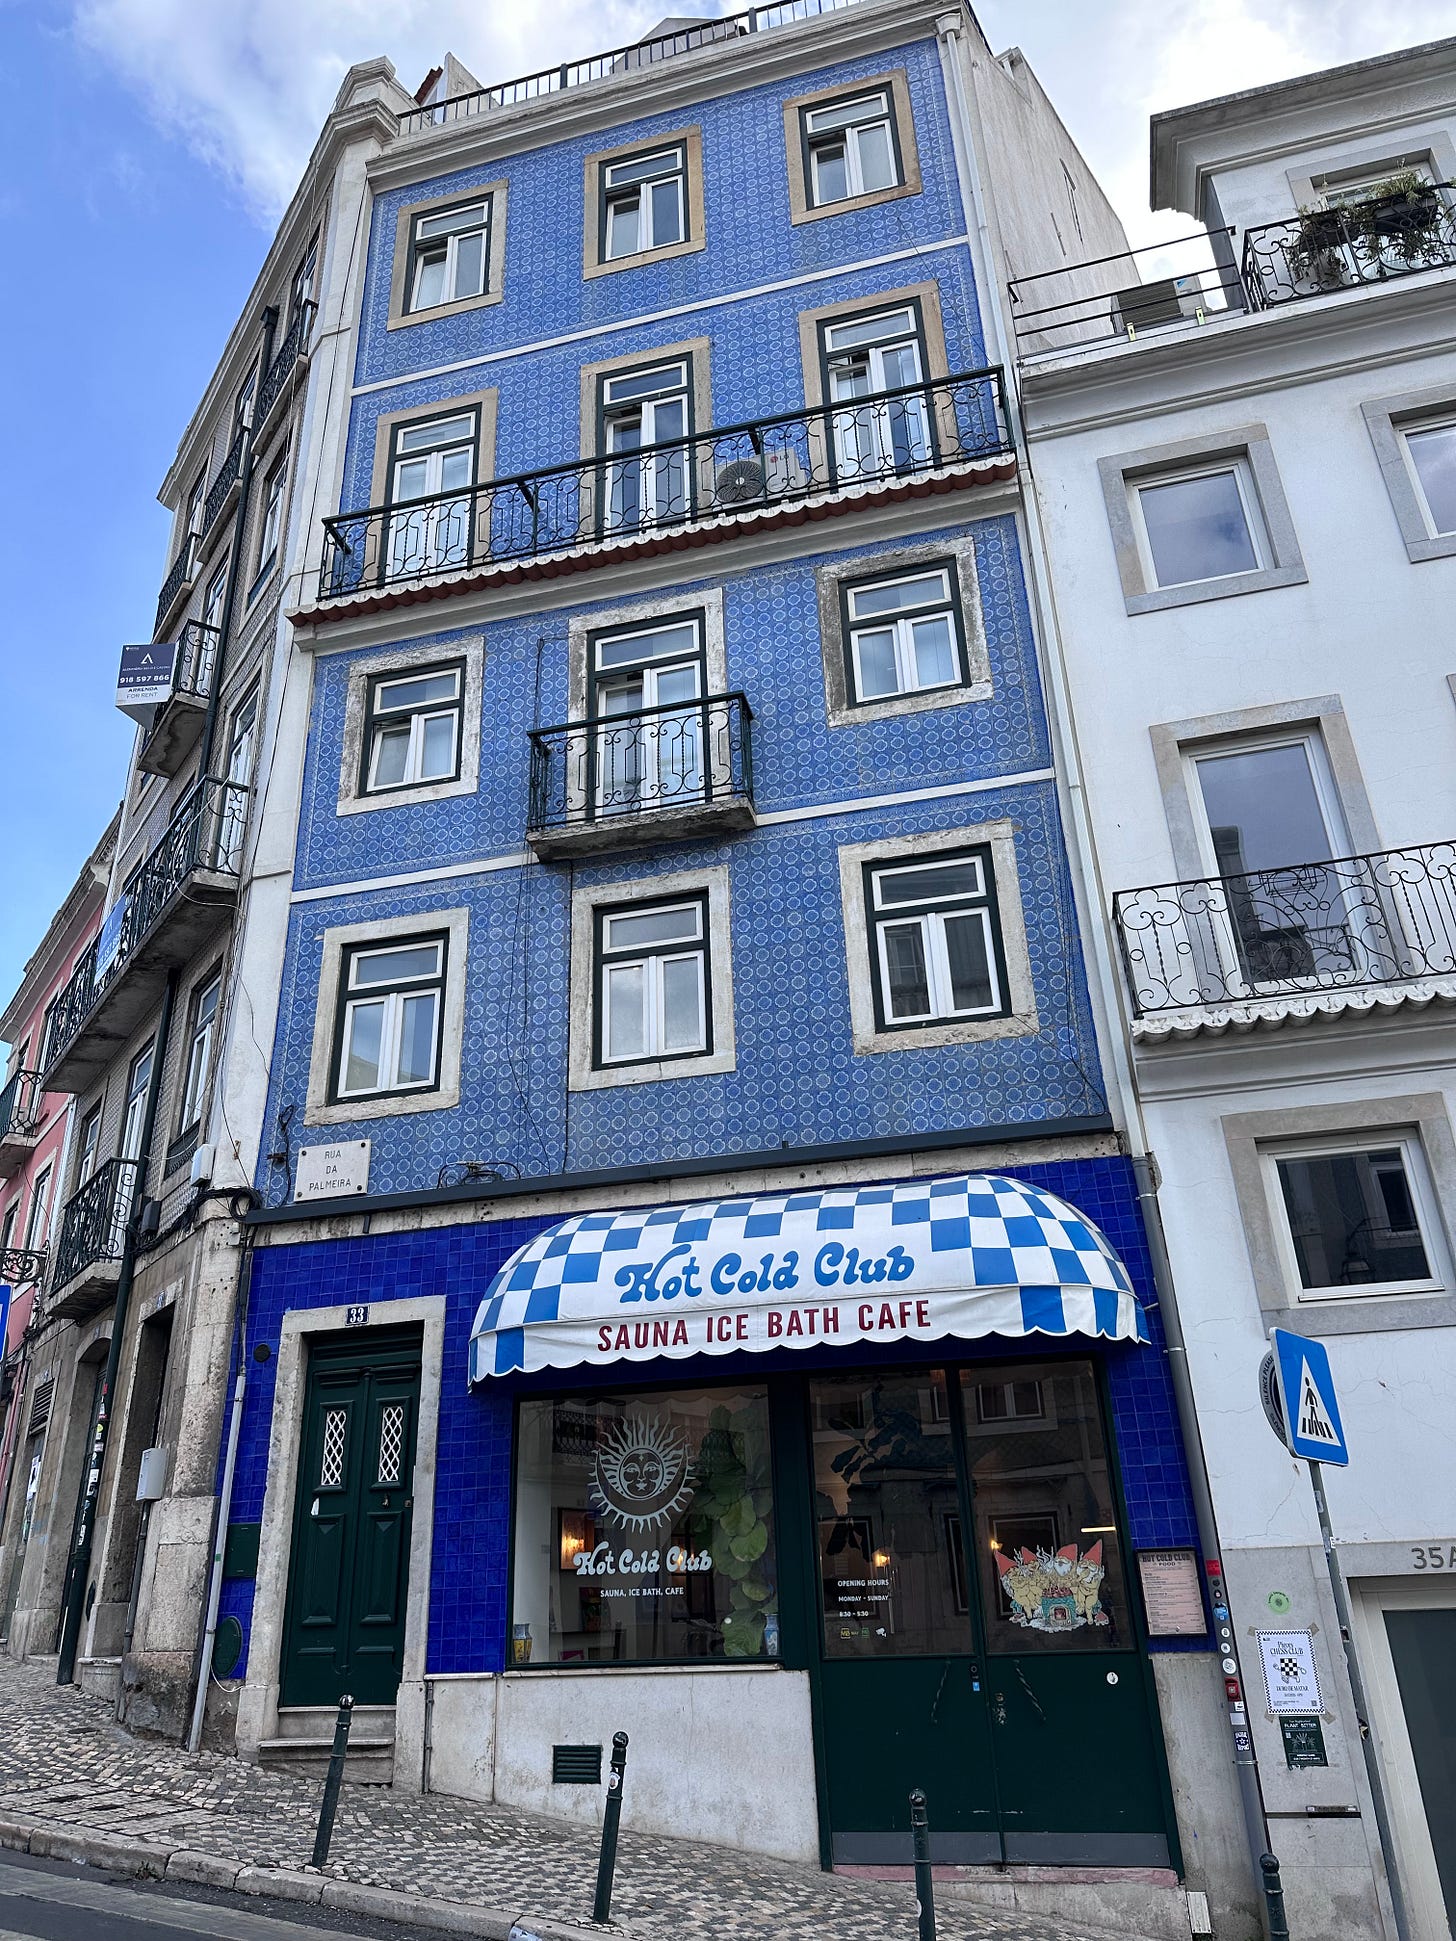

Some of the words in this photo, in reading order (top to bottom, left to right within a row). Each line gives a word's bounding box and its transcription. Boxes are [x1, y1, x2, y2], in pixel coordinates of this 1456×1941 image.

[325, 1150, 341, 1159] RUA
[326, 1165, 337, 1174] DA
[309, 1178, 351, 1191] PALMEIRA
[614, 1243, 702, 1303] Hot
[710, 1250, 799, 1295] Cold
[813, 1241, 915, 1287] Club
[350, 1308, 364, 1323] 33
[597, 1319, 689, 1351] SAUNA
[706, 1313, 749, 1342] ICE
[767, 1307, 840, 1338] BATH
[858, 1300, 931, 1331] CAFE
[1262, 1375, 1270, 1405] SILENCE
[573, 1541, 615, 1575] Hot
[618, 1549, 660, 1574] Cold
[666, 1546, 712, 1573] Club
[1142, 1554, 1155, 1562] HOT
[1156, 1553, 1173, 1562] COLD
[1173, 1553, 1191, 1561] CLUB
[600, 1589, 627, 1597] SAUNA,
[629, 1588, 641, 1596] ICE
[665, 1587, 684, 1595] CAFE
